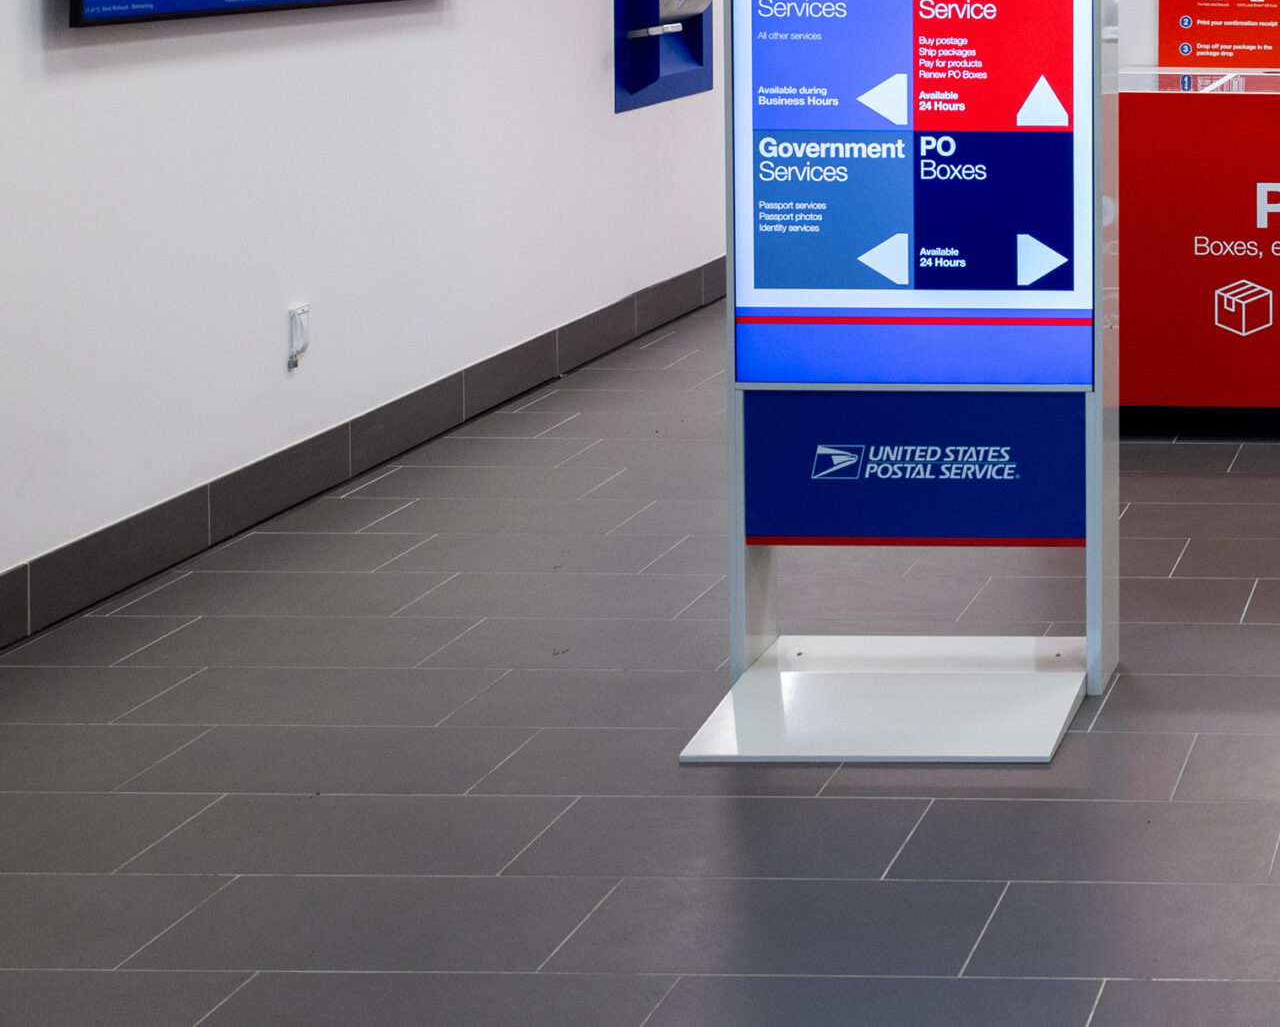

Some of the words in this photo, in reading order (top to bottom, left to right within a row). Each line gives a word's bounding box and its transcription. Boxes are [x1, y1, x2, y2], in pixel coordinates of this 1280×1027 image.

[757, 31, 767, 40] All
[769, 31, 789, 40] other
[790, 31, 822, 40] services
[919, 36, 934, 46] Buy
[936, 37, 968, 46] postage
[1196, 43, 1210, 51] Drop
[919, 48, 937, 57] Ship
[938, 48, 976, 58] packages
[919, 59, 934, 68] Pay
[935, 59, 946, 67] for
[948, 59, 982, 68] products
[919, 70, 946, 79] Renew
[948, 70, 961, 79] PO
[962, 70, 987, 79] Boxes
[758, 86, 797, 94] Available
[799, 86, 827, 96] during
[919, 91, 958, 100] Available
[758, 96, 805, 106] Business
[808, 96, 839, 106] Hours
[919, 101, 932, 111] 24
[934, 101, 966, 111] Hours
[759, 137, 906, 158] Government
[920, 136, 956, 157] PO
[759, 161, 848, 182] Services
[921, 160, 987, 180] Boxes
[759, 201, 793, 210] Passport
[795, 201, 827, 210] services
[759, 212, 793, 221] Passport
[795, 212, 823, 221] photos
[759, 223, 786, 233] Identity
[788, 223, 820, 232] services
[919, 247, 959, 256] Available
[1194, 236, 1263, 259] Boxes,
[919, 257, 933, 267] 24
[935, 257, 966, 267] Hours
[868, 445, 942, 462] UNITED
[943, 446, 1011, 462] STATES
[864, 464, 936, 479] POSTAL
[939, 464, 1017, 479] SERVICE
